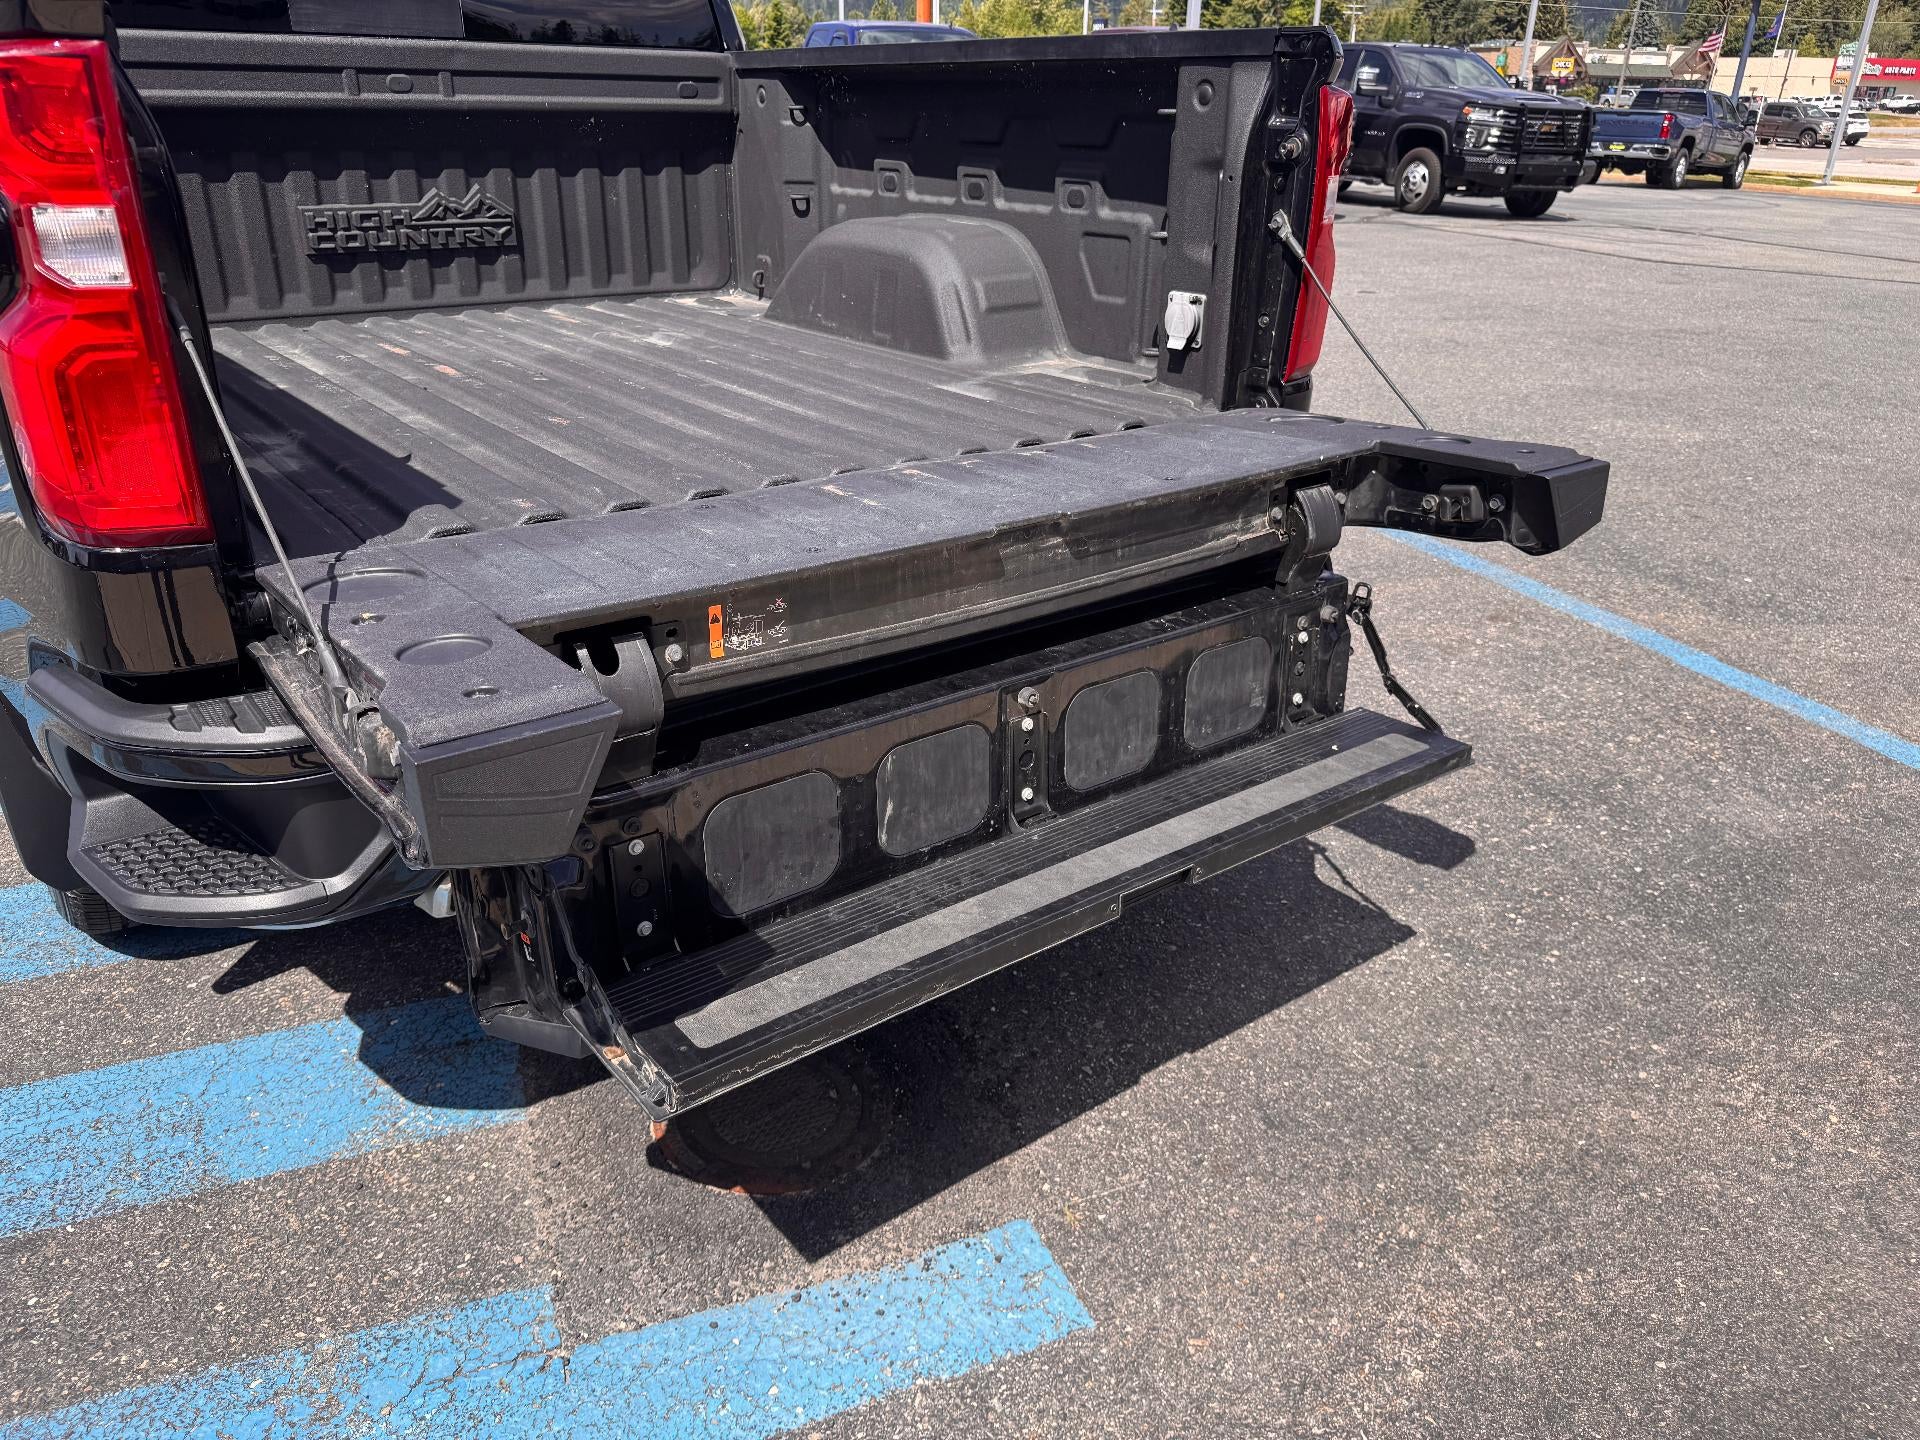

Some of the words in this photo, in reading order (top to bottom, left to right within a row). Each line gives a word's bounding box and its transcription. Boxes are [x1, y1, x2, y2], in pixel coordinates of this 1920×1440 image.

[1885, 66, 1899, 75] AUTO
[1900, 67, 1916, 76] PARTS
[304, 209, 413, 229] HIGH
[307, 225, 512, 249] COUNTRY
